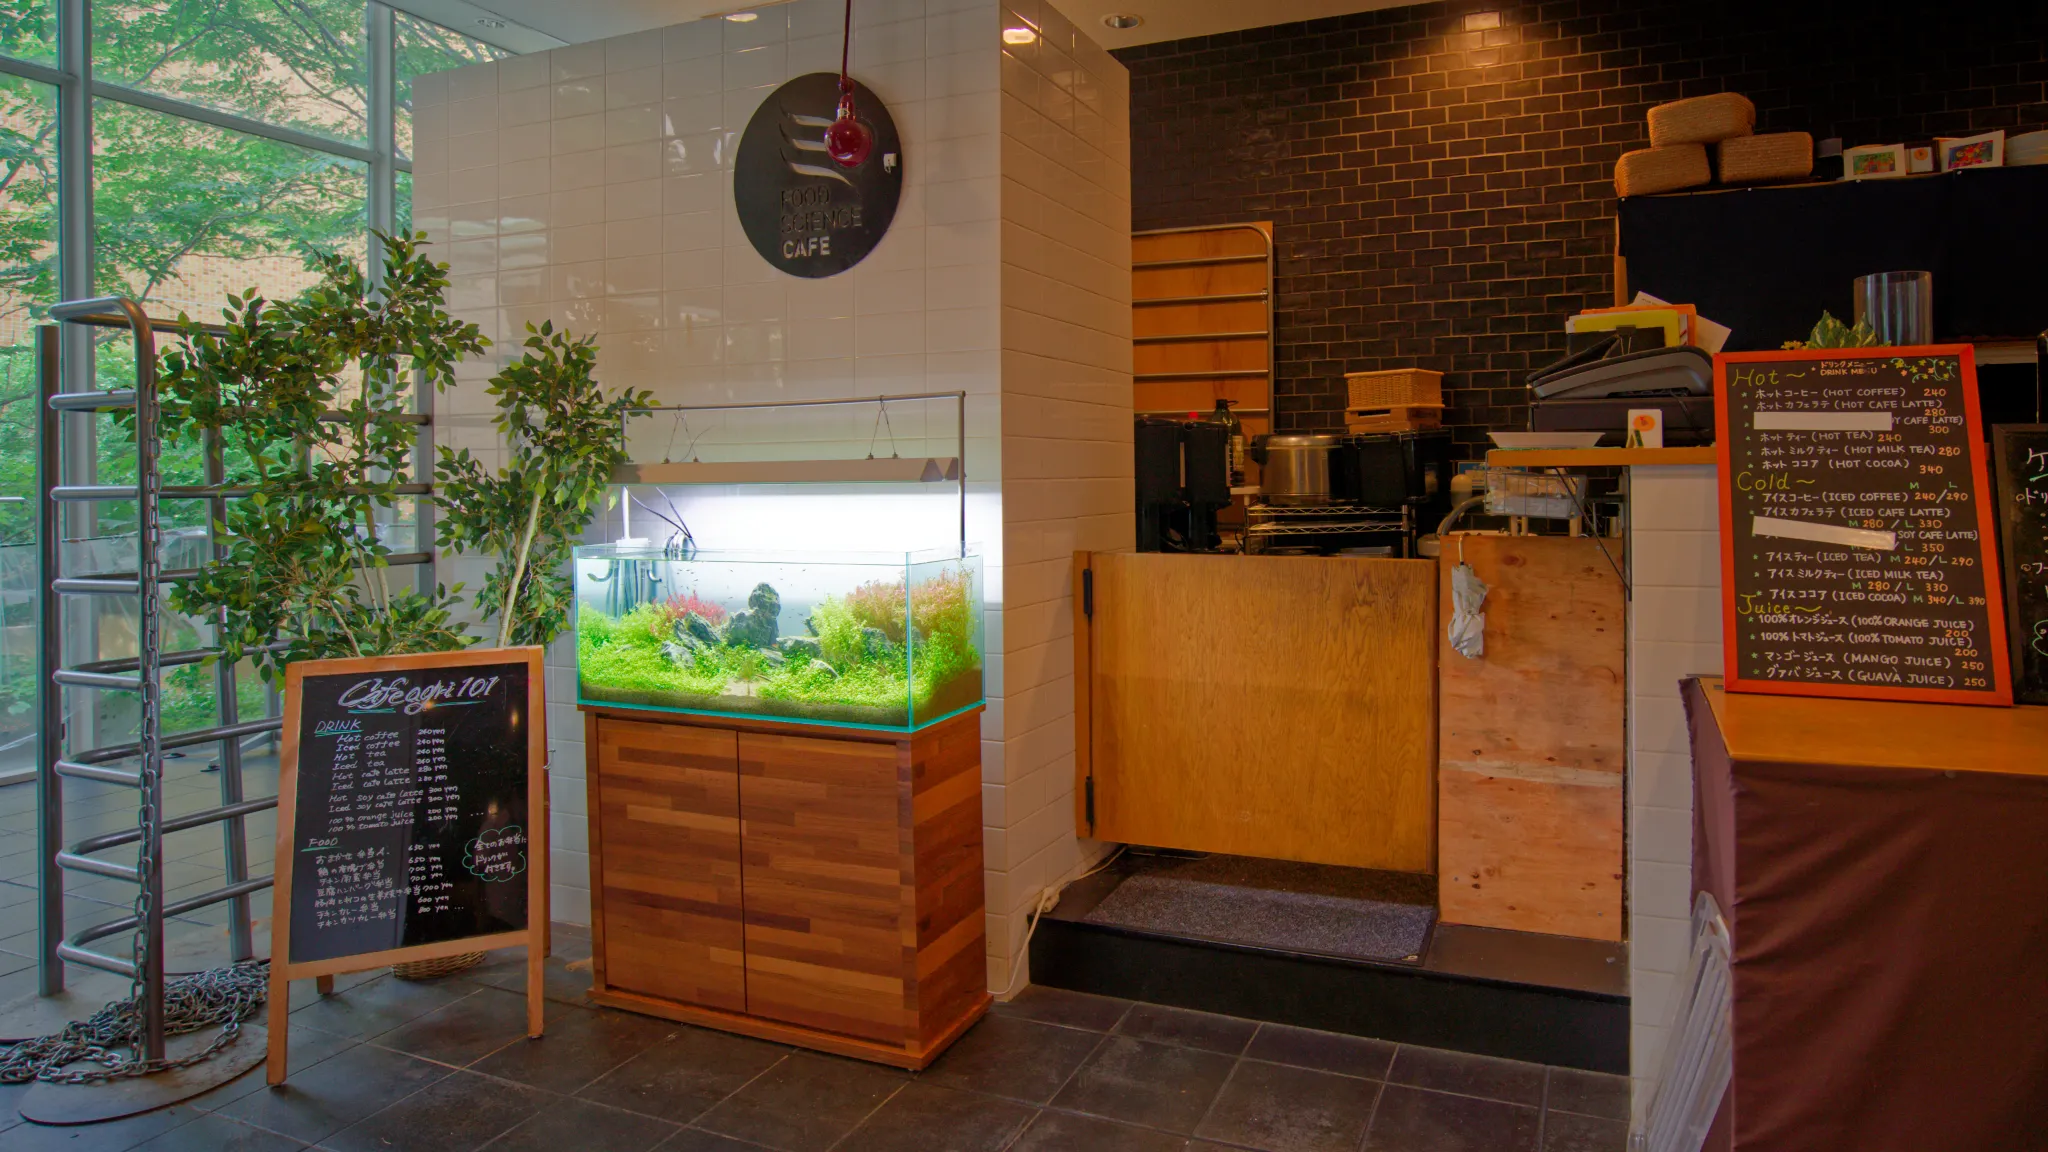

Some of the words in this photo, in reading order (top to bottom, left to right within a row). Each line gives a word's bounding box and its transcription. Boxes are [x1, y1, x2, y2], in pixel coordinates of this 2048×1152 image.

[781, 185, 830, 211] FOOD
[781, 206, 863, 234] SCIENCE
[783, 236, 831, 259] CAFE
[1732, 368, 1779, 387] Hot
[1820, 368, 1848, 376] DRINK
[1823, 388, 1852, 398] (HOT
[1857, 387, 1906, 398] COFFEE)
[1924, 388, 1947, 397] 240
[1835, 400, 1866, 410] (HOT
[1869, 400, 1898, 409] CAFE
[1901, 400, 1943, 408] LATTE)
[1924, 408, 1946, 416] 280
[1903, 416, 1929, 425] CAFE
[1932, 416, 1963, 426] LATTE)
[1929, 425, 1949, 434] 300
[1811, 431, 1841, 442] (HOT
[1845, 430, 1873, 440] TEA)
[1878, 433, 1902, 442] 240
[1844, 446, 1873, 456] (HOT
[1877, 445, 1905, 454] MILK
[1909, 445, 1935, 456] TEA)
[1938, 447, 1961, 456] 280
[1828, 459, 1861, 469] (HOT
[1865, 458, 1910, 468] COCOA)
[1919, 464, 1943, 474] 340
[1737, 471, 1790, 492] Cold
[1948, 481, 1958, 489] L
[1822, 492, 1856, 502] (ICED
[1859, 492, 1908, 502] COFFEE)
[1840, 506, 1875, 518] (ICED
[1878, 508, 1905, 517] CAFE
[1909, 507, 1950, 518] LATTE)
[1849, 520, 1858, 528] M
[1863, 519, 1884, 528] 280
[1905, 520, 1913, 528] L
[1919, 520, 1942, 528] 330
[1898, 530, 1916, 540] SOY
[1919, 531, 1944, 540] CAFE
[1946, 531, 1978, 541] LATTE)
[1904, 543, 1913, 551] L
[1921, 543, 1944, 552] 350
[1816, 552, 1848, 563] (ICED
[1852, 552, 1881, 563] TEA)
[1951, 557, 1974, 567] 290
[1847, 570, 1881, 580] (ICED
[1884, 570, 1912, 579] MILK
[1916, 570, 1944, 581] TEA)
[1852, 582, 1861, 590] M
[1867, 582, 1890, 590] 280
[1906, 583, 1914, 591] L
[1925, 582, 1948, 592] 330
[1832, 590, 1864, 601] (ICED
[1868, 592, 1906, 604] COCOA)
[1913, 595, 1923, 604] M
[1968, 597, 1985, 606] 390
[1737, 594, 1790, 615] Juice
[1884, 616, 1929, 628] ORANGE
[1932, 618, 1974, 631] JUICE)
[1944, 630, 1969, 638] 200
[1882, 634, 1924, 645] TOMATO
[1928, 636, 1972, 648] JUICE)
[1954, 648, 1978, 658] 200
[1843, 652, 1898, 666] (MANGO
[1904, 656, 1950, 669] JUICE)
[1962, 660, 1984, 671] 250
[456, 676, 500, 697] 101
[1906, 674, 1954, 688] JUICE)
[1964, 678, 1986, 688] 250
[314, 719, 361, 733] DRINK
[337, 734, 361, 744] Hot
[364, 731, 399, 741] coffee
[336, 742, 360, 752] Iced
[366, 740, 400, 750] coffee
[334, 752, 356, 761] Hot
[332, 760, 358, 770] Iced
[332, 772, 354, 780] Hot
[384, 768, 410, 776] latte
[332, 782, 354, 790] Iced
[384, 778, 410, 786] latte
[329, 794, 348, 803] Hot
[356, 794, 374, 802] soy
[400, 789, 424, 798] latte
[329, 804, 351, 813] Iced
[398, 797, 422, 806] latte
[358, 811, 388, 822] orange
[391, 810, 414, 820] juice
[359, 821, 389, 830] tomato
[390, 818, 415, 827] juice
[308, 838, 338, 848] FOOD
